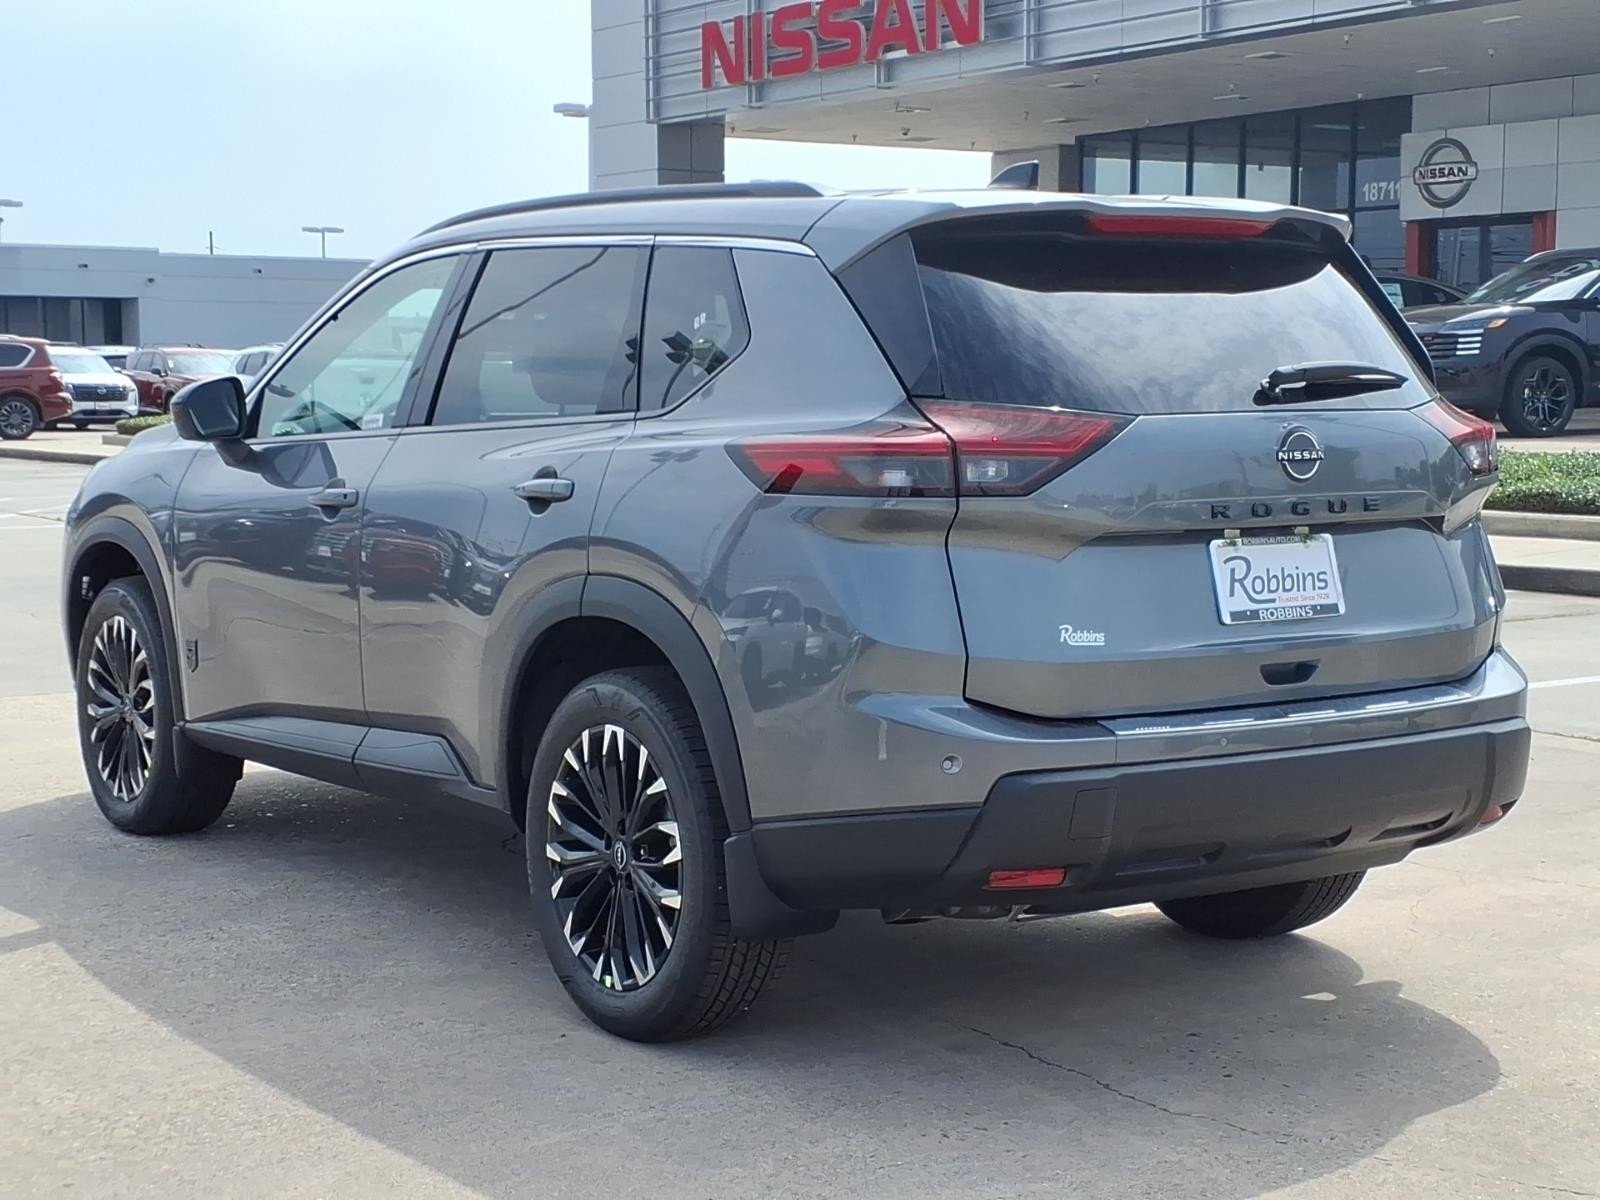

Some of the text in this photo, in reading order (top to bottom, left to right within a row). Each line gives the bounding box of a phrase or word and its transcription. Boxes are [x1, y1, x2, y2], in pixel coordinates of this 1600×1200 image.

[701, 0, 985, 90] NISSAN
[1418, 164, 1469, 180] NISSAN
[1362, 180, 1400, 202] 18711
[1278, 450, 1325, 461] NISSAN
[1210, 497, 1381, 520] ROGUE
[1223, 555, 1329, 605] Robbins
[1259, 605, 1314, 620] ROBBINS
[1058, 624, 1105, 646] Robbins
